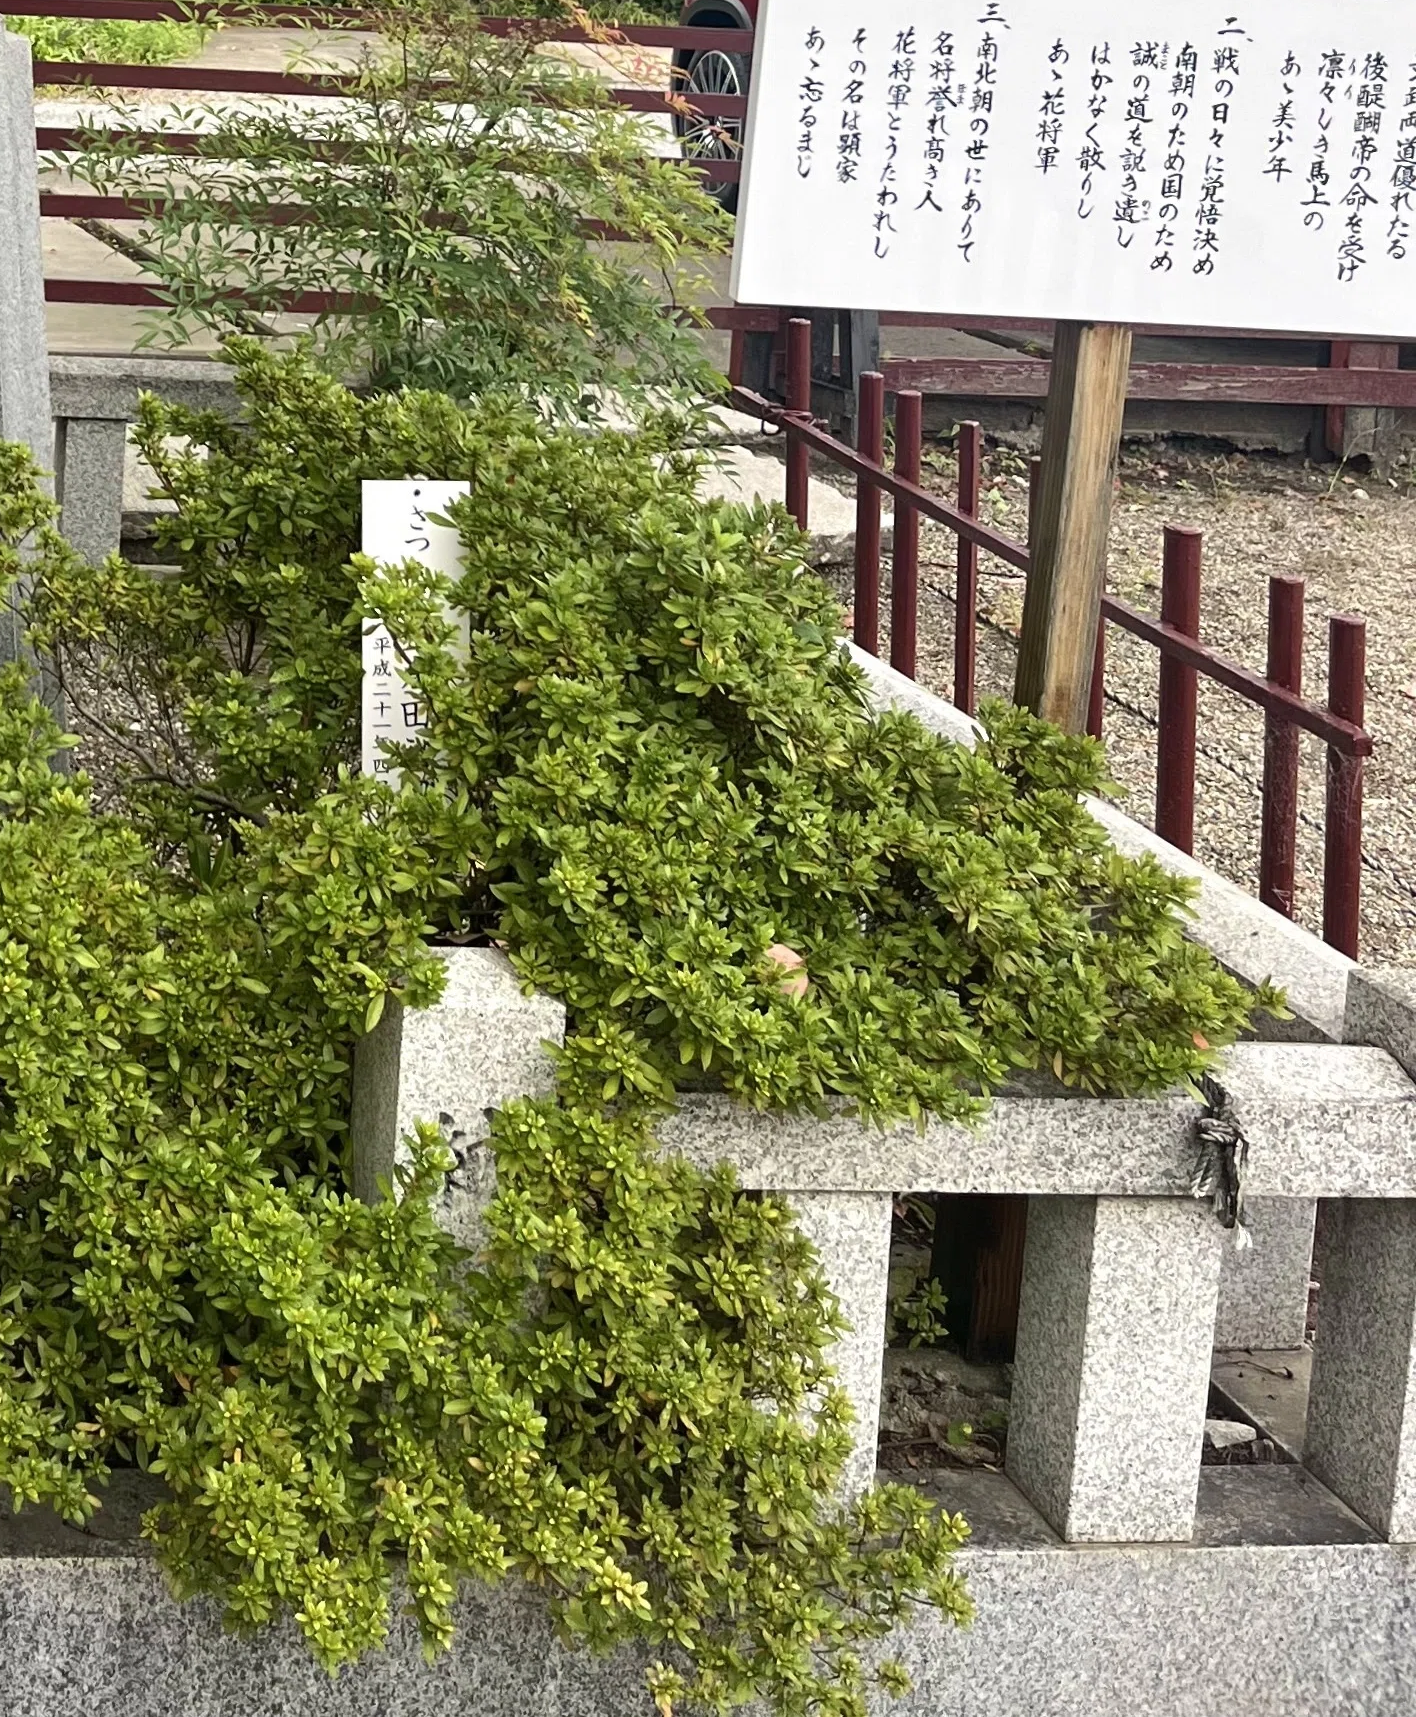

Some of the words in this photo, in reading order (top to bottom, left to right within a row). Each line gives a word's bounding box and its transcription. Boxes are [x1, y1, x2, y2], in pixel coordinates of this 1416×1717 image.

[872, 25, 917, 259] 花将軍とうたわれし
[1075, 41, 1114, 219] はかなく散りし
[1150, 41, 1198, 273] 南朝のため国のため
